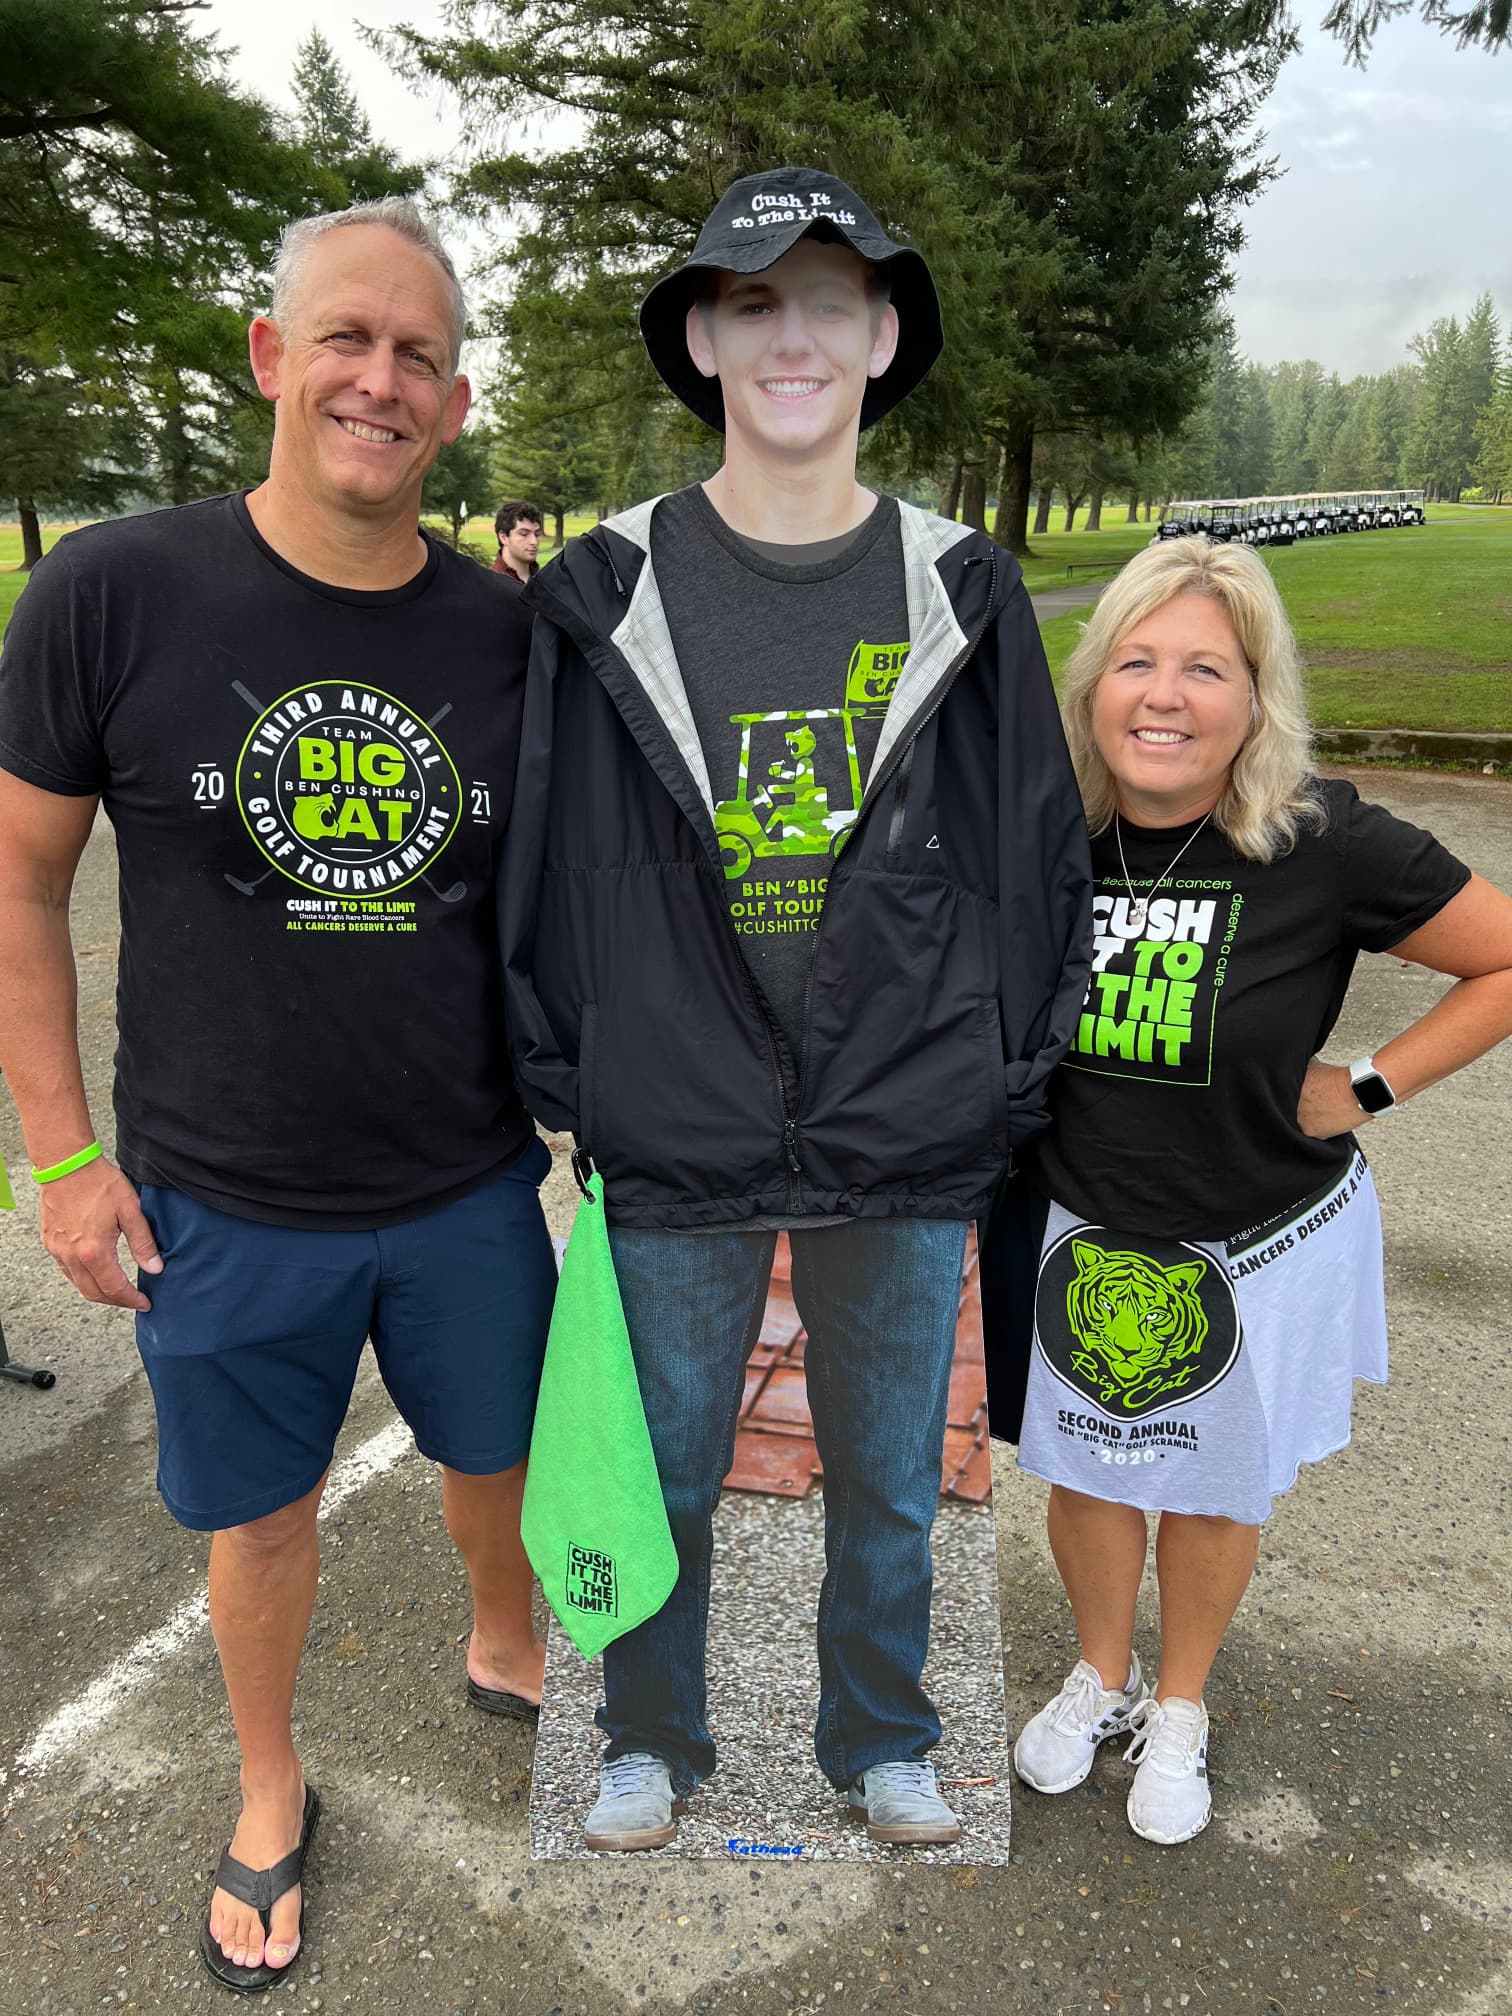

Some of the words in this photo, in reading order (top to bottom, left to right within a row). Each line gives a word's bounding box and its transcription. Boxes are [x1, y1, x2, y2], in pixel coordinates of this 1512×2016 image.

[751, 193, 804, 211] Cush
[809, 193, 831, 206] It
[731, 217, 754, 228] To
[758, 210, 794, 226] The
[251, 692, 323, 756] THIRD
[340, 690, 441, 769] ANNUAL
[322, 726, 372, 740] TEAM
[298, 737, 406, 786] BIG
[191, 771, 224, 800] 20
[285, 781, 321, 792] BEN
[331, 784, 420, 800] CUSHING
[471, 789, 490, 816] 21
[292, 793, 412, 841] CAT
[248, 797, 296, 857] GOLF
[296, 806, 450, 890] TOURNAMENT
[742, 881, 780, 897] BEN
[1103, 877, 1153, 887] Because
[1158, 878, 1172, 887] all
[1176, 879, 1232, 890] cancers
[286, 899, 321, 912] CUSH
[324, 900, 338, 912] IT
[340, 901, 358, 913] TO
[360, 901, 383, 913] THE
[386, 902, 416, 913] LIMIT
[1093, 895, 1217, 944] CUSH
[1224, 893, 1244, 942] deserve
[286, 921, 302, 930] ALL
[305, 922, 345, 931] CANCERS
[349, 922, 384, 931] DESERVE
[387, 923, 394, 931] A
[396, 923, 417, 932] CURE
[1092, 935, 1126, 972] T
[1133, 941, 1204, 981] TO
[1221, 944, 1231, 954] a
[1213, 958, 1228, 987] cure
[1096, 972, 1198, 1027] THE
[1069, 1013, 1192, 1066] IMIT
[1229, 1233, 1295, 1280] CANCERS
[1296, 1188, 1351, 1240] DESERVE
[1349, 1178, 1358, 1195] A
[1069, 1351, 1121, 1402] Big
[1122, 1365, 1200, 1408] Cat
[1058, 1409, 1122, 1440] SECOND
[1129, 1421, 1198, 1440] ANNUAL
[1058, 1424, 1074, 1437] BEN
[1126, 1440, 1148, 1450] GOLF
[1150, 1439, 1199, 1451] SCRAMBLE
[1100, 1449, 1155, 1465] 2020
[571, 1562, 587, 1578] IT
[590, 1568, 612, 1586] TO
[572, 1548, 612, 1573] CUSH
[570, 1591, 613, 1613] LIMIT
[581, 1580, 613, 1600] THE
[726, 1837, 804, 1854] Fathead
